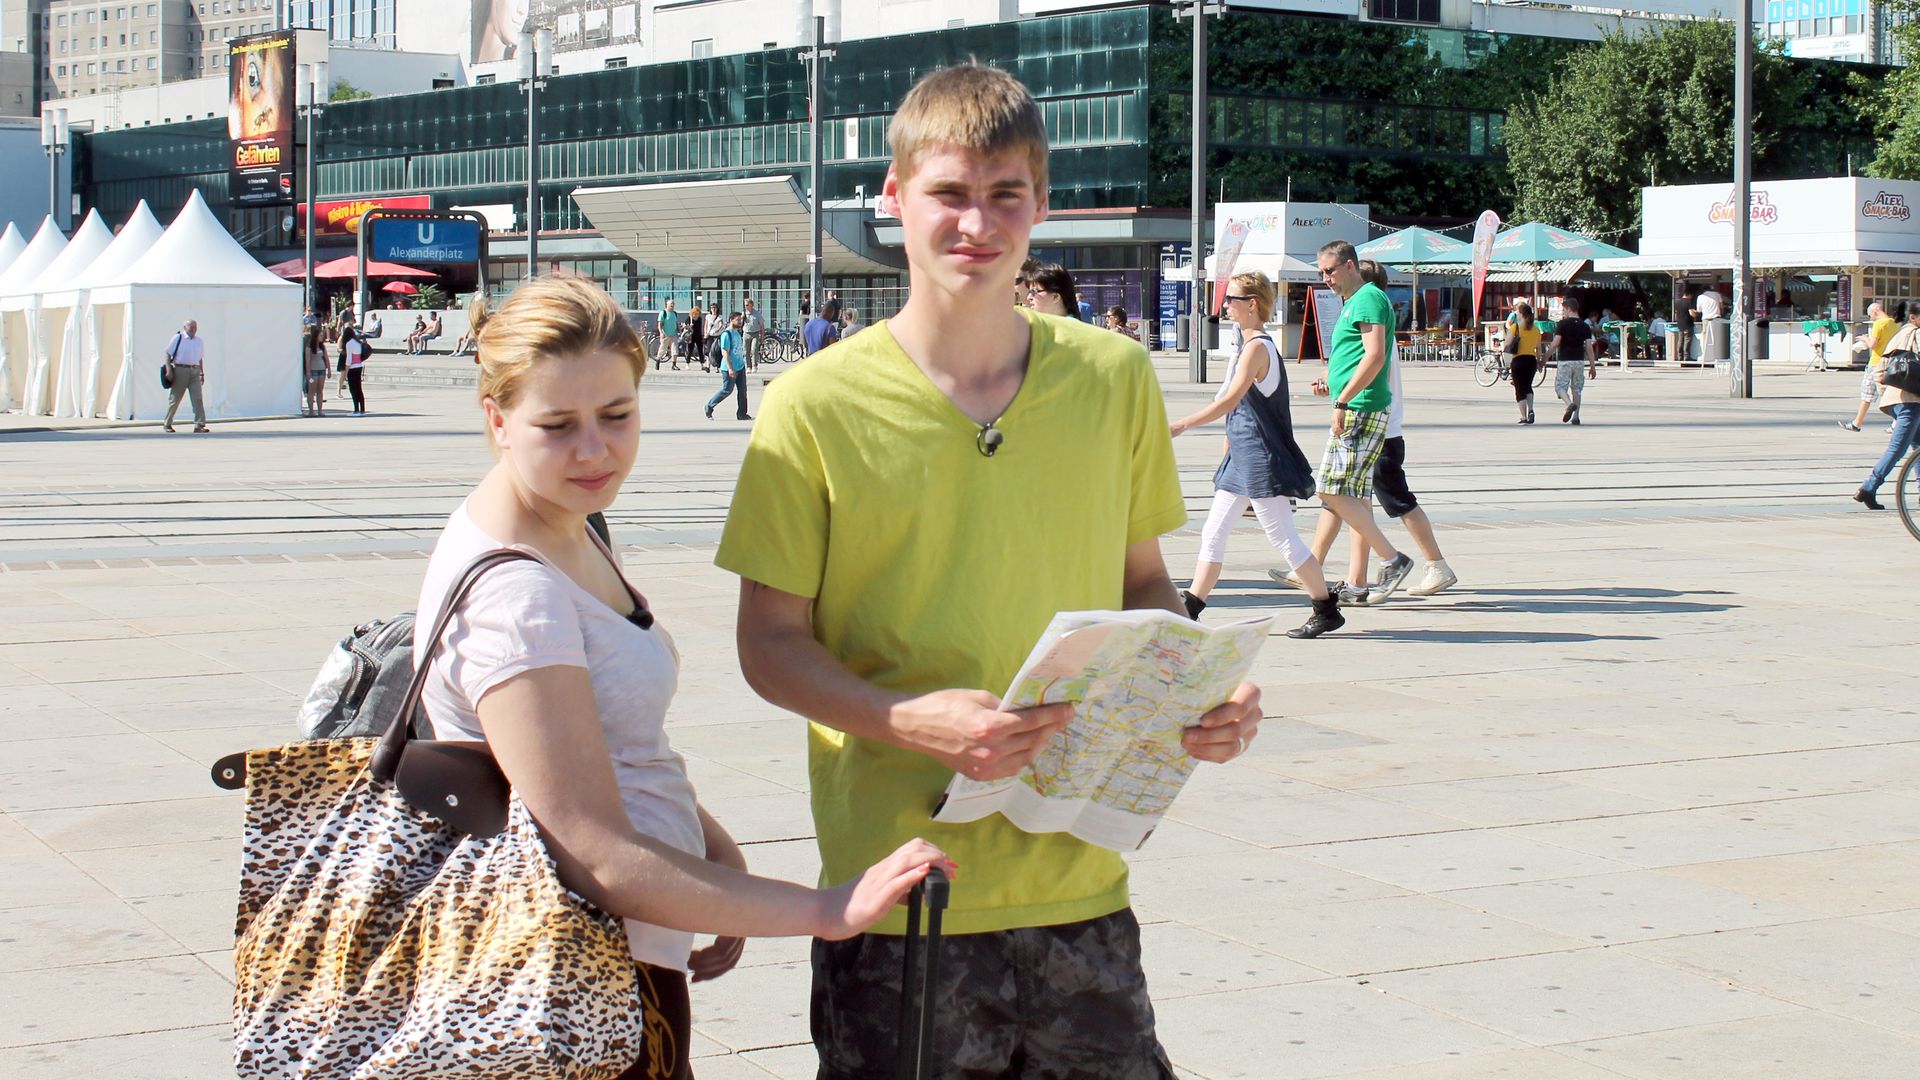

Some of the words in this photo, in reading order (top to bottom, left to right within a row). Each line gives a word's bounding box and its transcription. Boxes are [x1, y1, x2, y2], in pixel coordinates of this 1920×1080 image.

[237, 144, 280, 166] Gefährten
[1876, 193, 1902, 206] ALEX
[418, 223, 434, 244] U
[389, 247, 463, 261] Alexanderplatz
